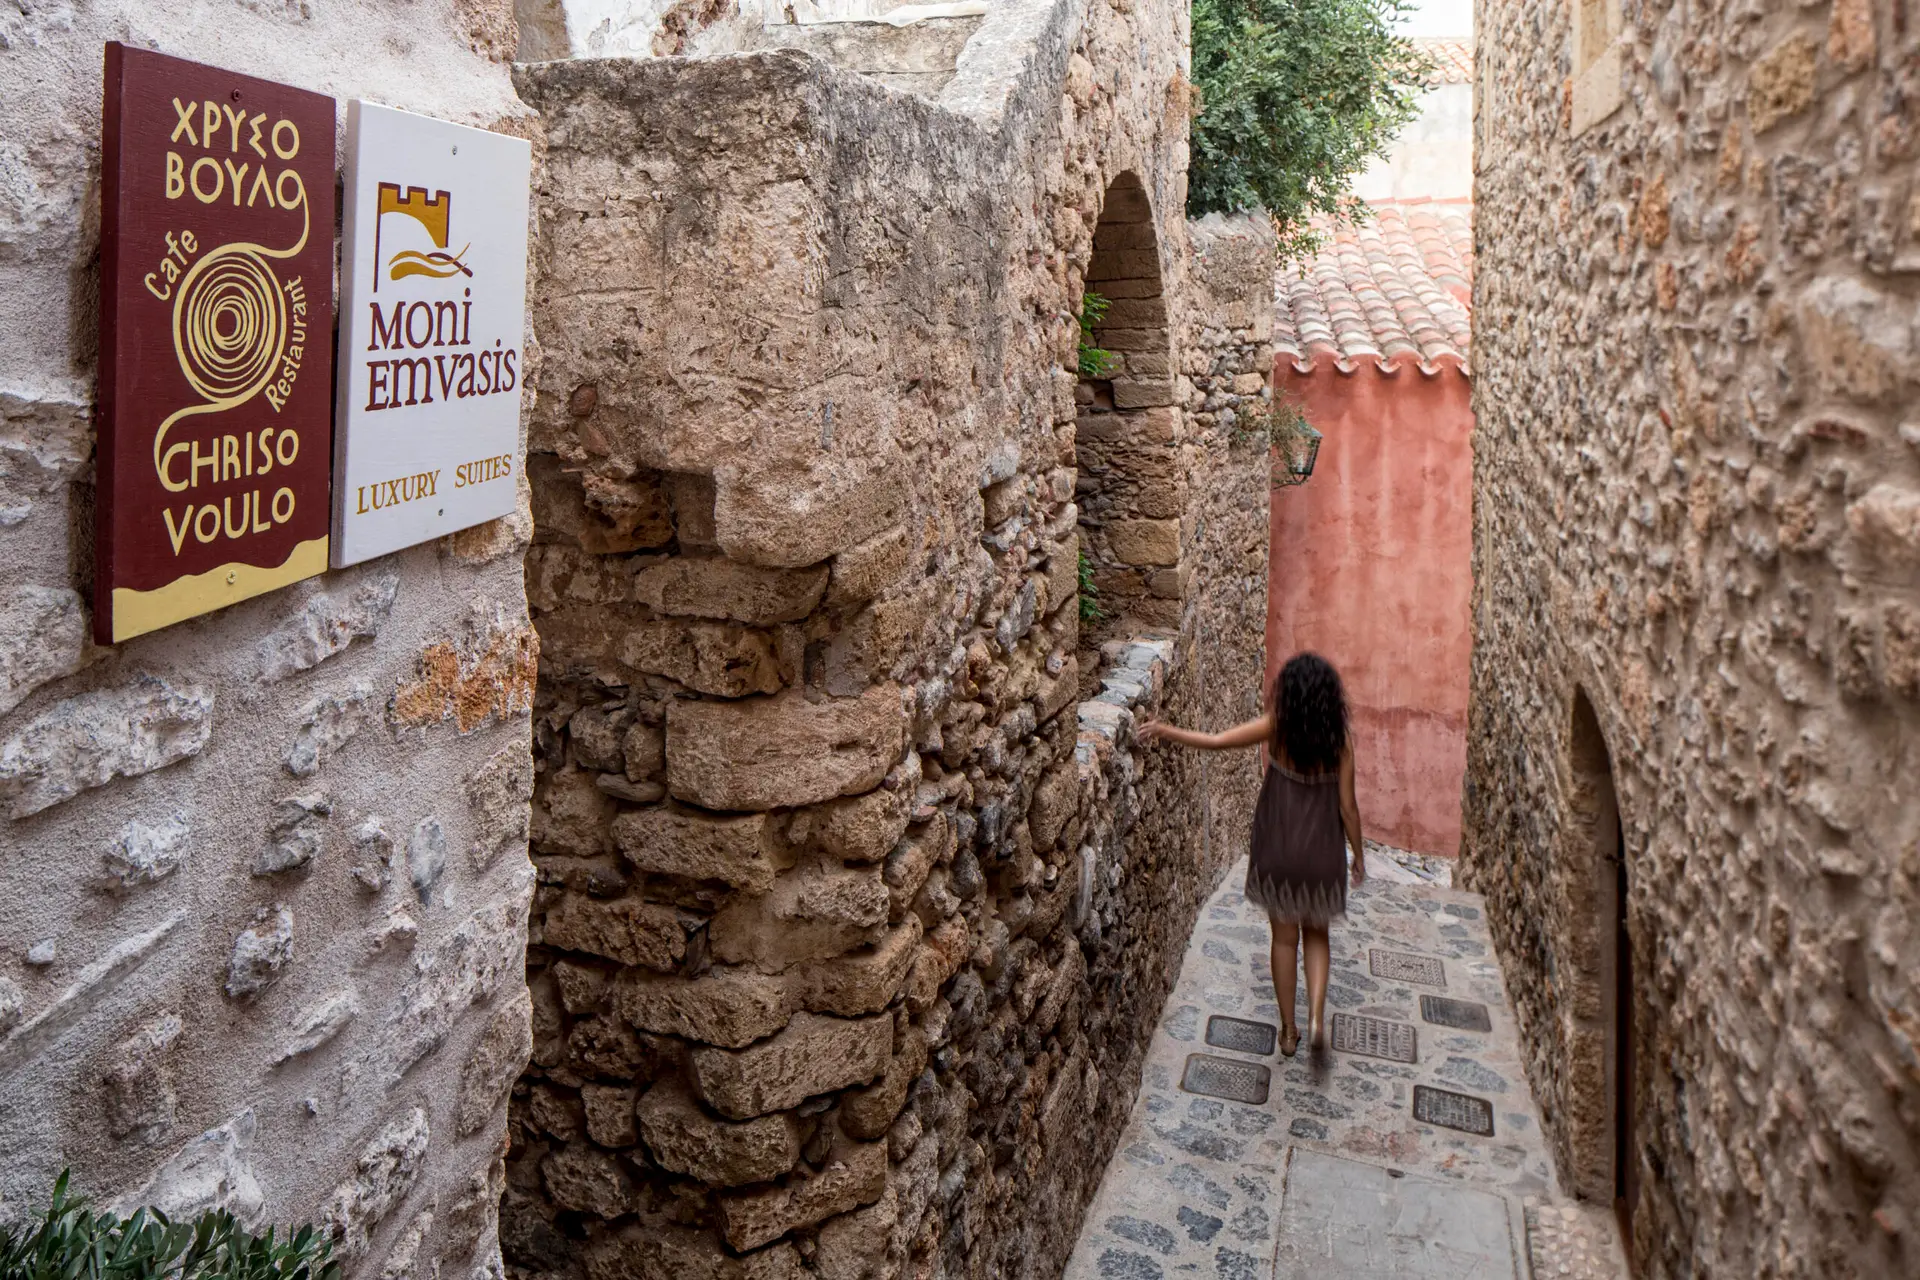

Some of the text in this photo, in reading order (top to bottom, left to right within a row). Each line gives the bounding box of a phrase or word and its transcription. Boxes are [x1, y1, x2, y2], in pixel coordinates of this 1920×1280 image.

[165, 151, 305, 210] ΒΟΥΛΟ
[144, 229, 198, 301] Cafe
[264, 275, 309, 413] Restaurant
[367, 287, 473, 352] Moni
[365, 338, 517, 412] Emvasis
[159, 427, 299, 493] CHRISO
[356, 453, 513, 515] LUXURY SUITES
[162, 486, 296, 557] VOULO
